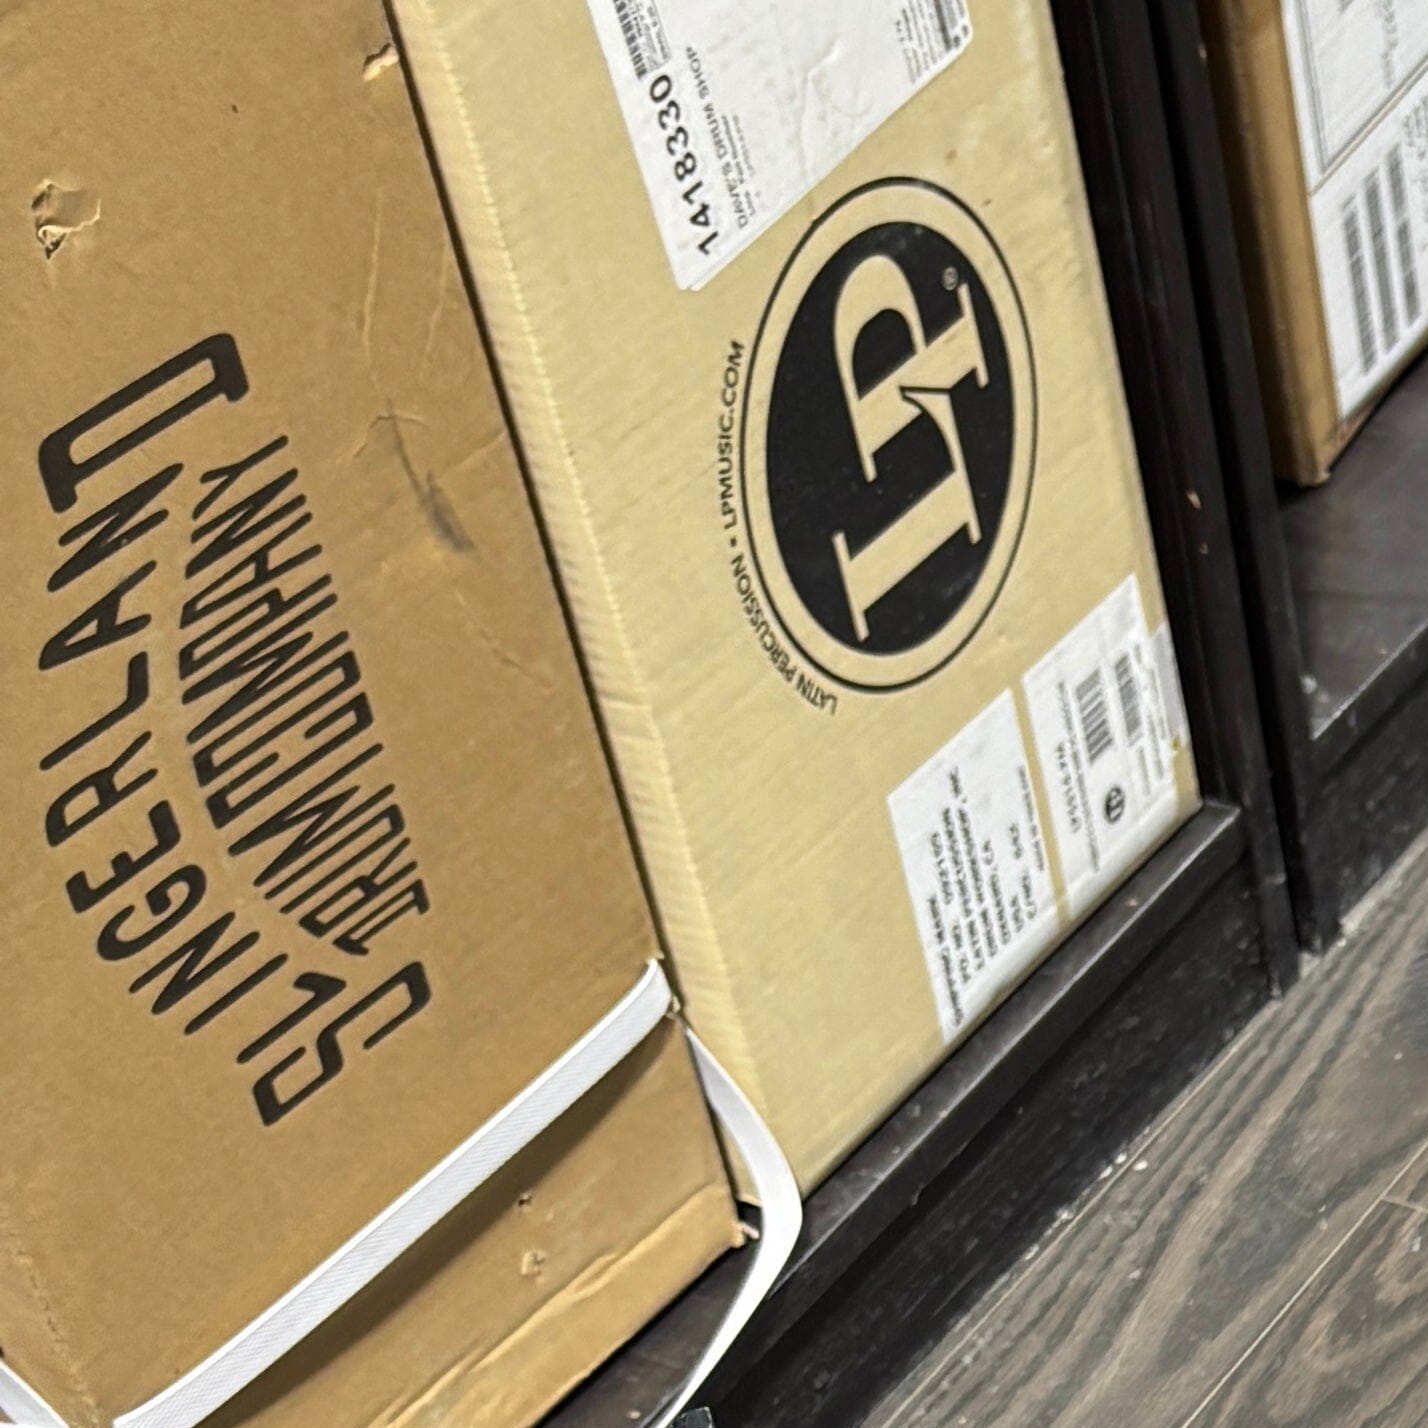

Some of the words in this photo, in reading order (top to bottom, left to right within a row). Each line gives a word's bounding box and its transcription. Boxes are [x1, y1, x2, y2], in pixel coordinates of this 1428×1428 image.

[685, 45, 710, 99] SHOP
[702, 102, 729, 160] DRUM
[649, 73, 719, 257] 1418330
[722, 162, 749, 229] DAVE'S
[714, 340, 745, 529] LPMUSIC.COM
[178, 435, 376, 831] COMPANY
[731, 554, 797, 682] PERCUSSION
[797, 673, 838, 716] LATIN
[38, 331, 432, 1127] SLINGERLAND
[229, 743, 432, 956] DRUM
